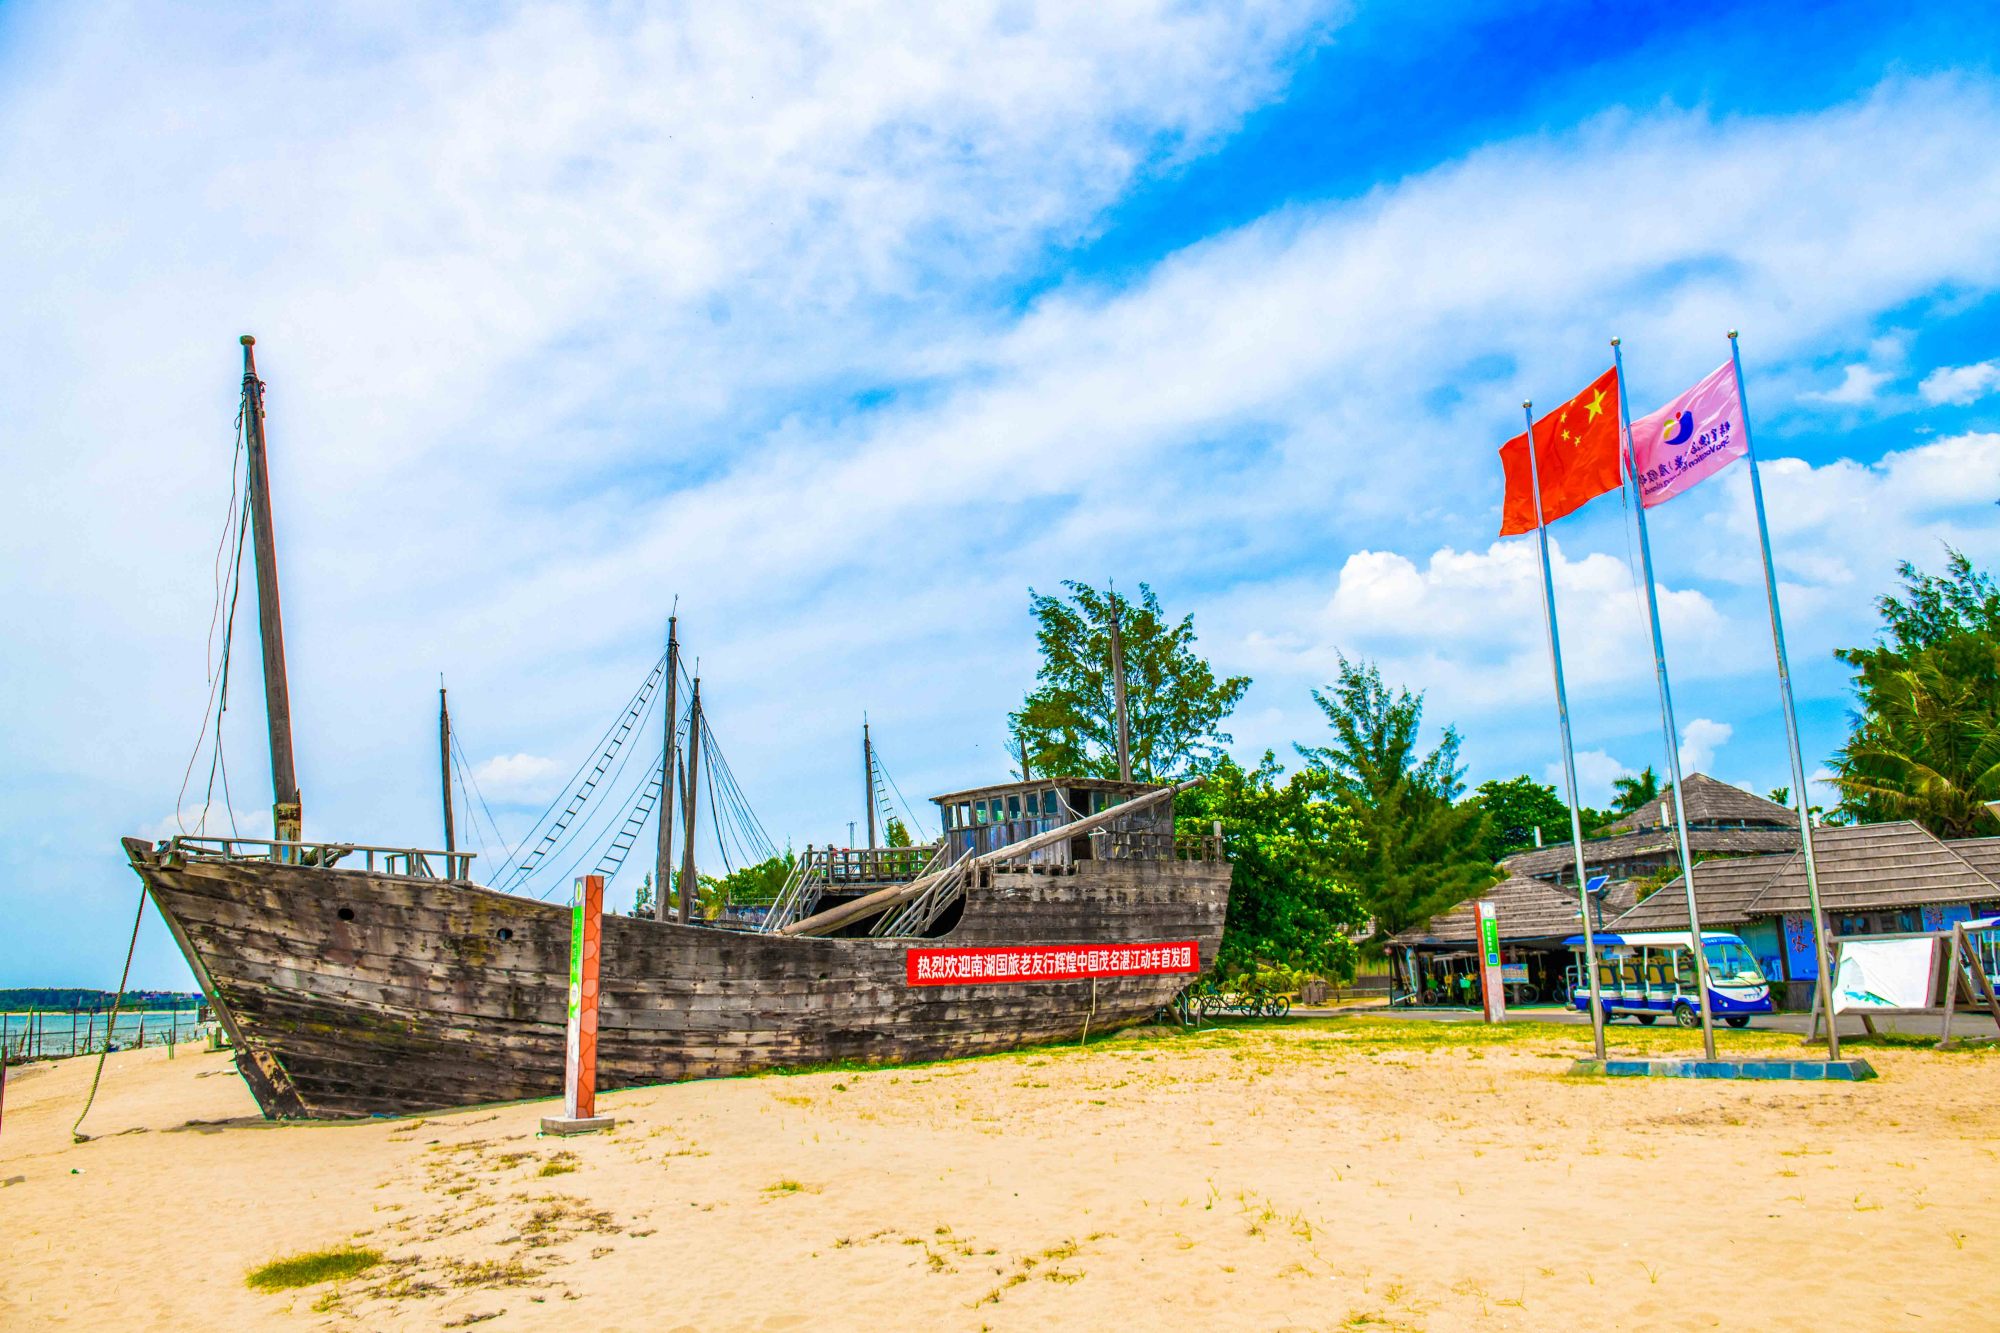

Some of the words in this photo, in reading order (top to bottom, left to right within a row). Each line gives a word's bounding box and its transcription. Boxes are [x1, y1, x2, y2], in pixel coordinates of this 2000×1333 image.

[917, 947, 1191, 980] 热烈欢迎南湖国旅老友行辉煌中国茂名湛江动车首发团
